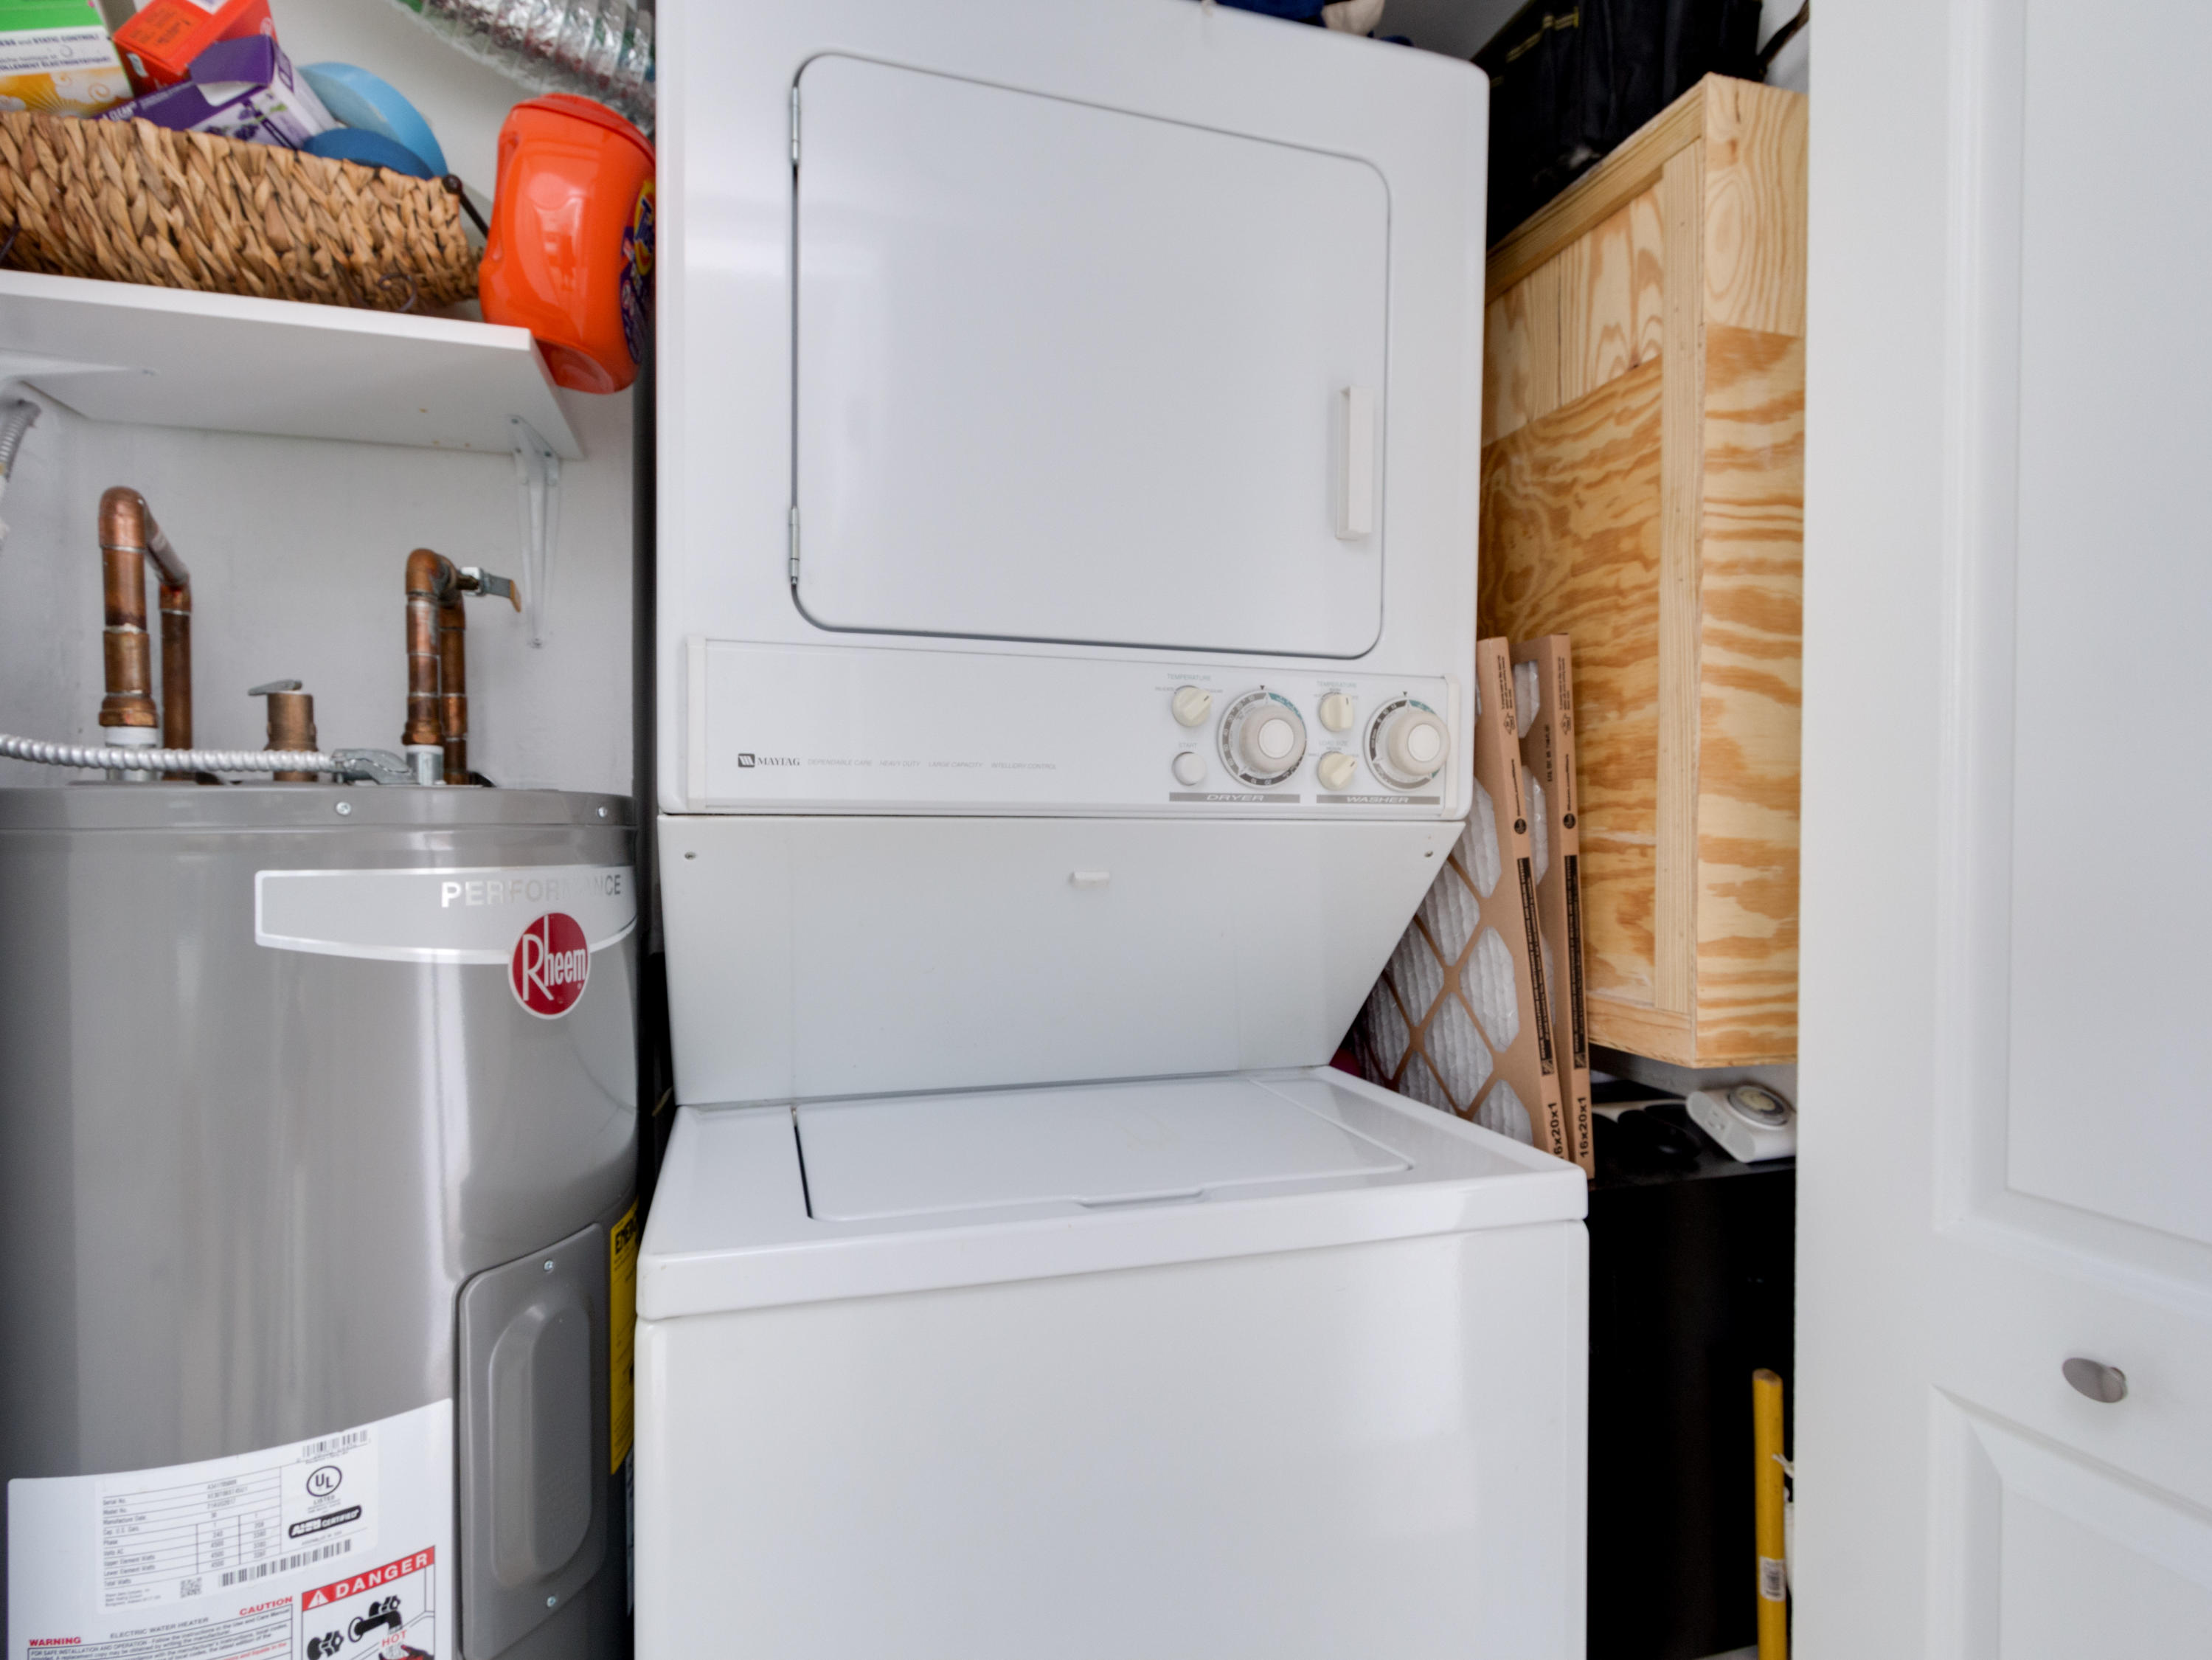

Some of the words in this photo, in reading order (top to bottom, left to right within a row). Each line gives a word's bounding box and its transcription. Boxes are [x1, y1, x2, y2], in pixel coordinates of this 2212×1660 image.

[757, 758, 800, 766] MAYTAG
[1206, 793, 1265, 802] DRYER
[522, 915, 587, 1000] Rheem
[1547, 1102, 1564, 1160] 6x20x1
[1577, 1096, 1589, 1158] 16x20x1
[315, 1473, 334, 1488] UL
[335, 1552, 429, 1599] DANGER
[239, 1596, 293, 1616] CAUTION
[110, 1628, 148, 1639] ELECTRIC
[150, 1623, 176, 1633] WATER
[178, 1616, 209, 1628] HEATER
[29, 1636, 82, 1647] WARNING
[381, 1630, 407, 1648] HOT
